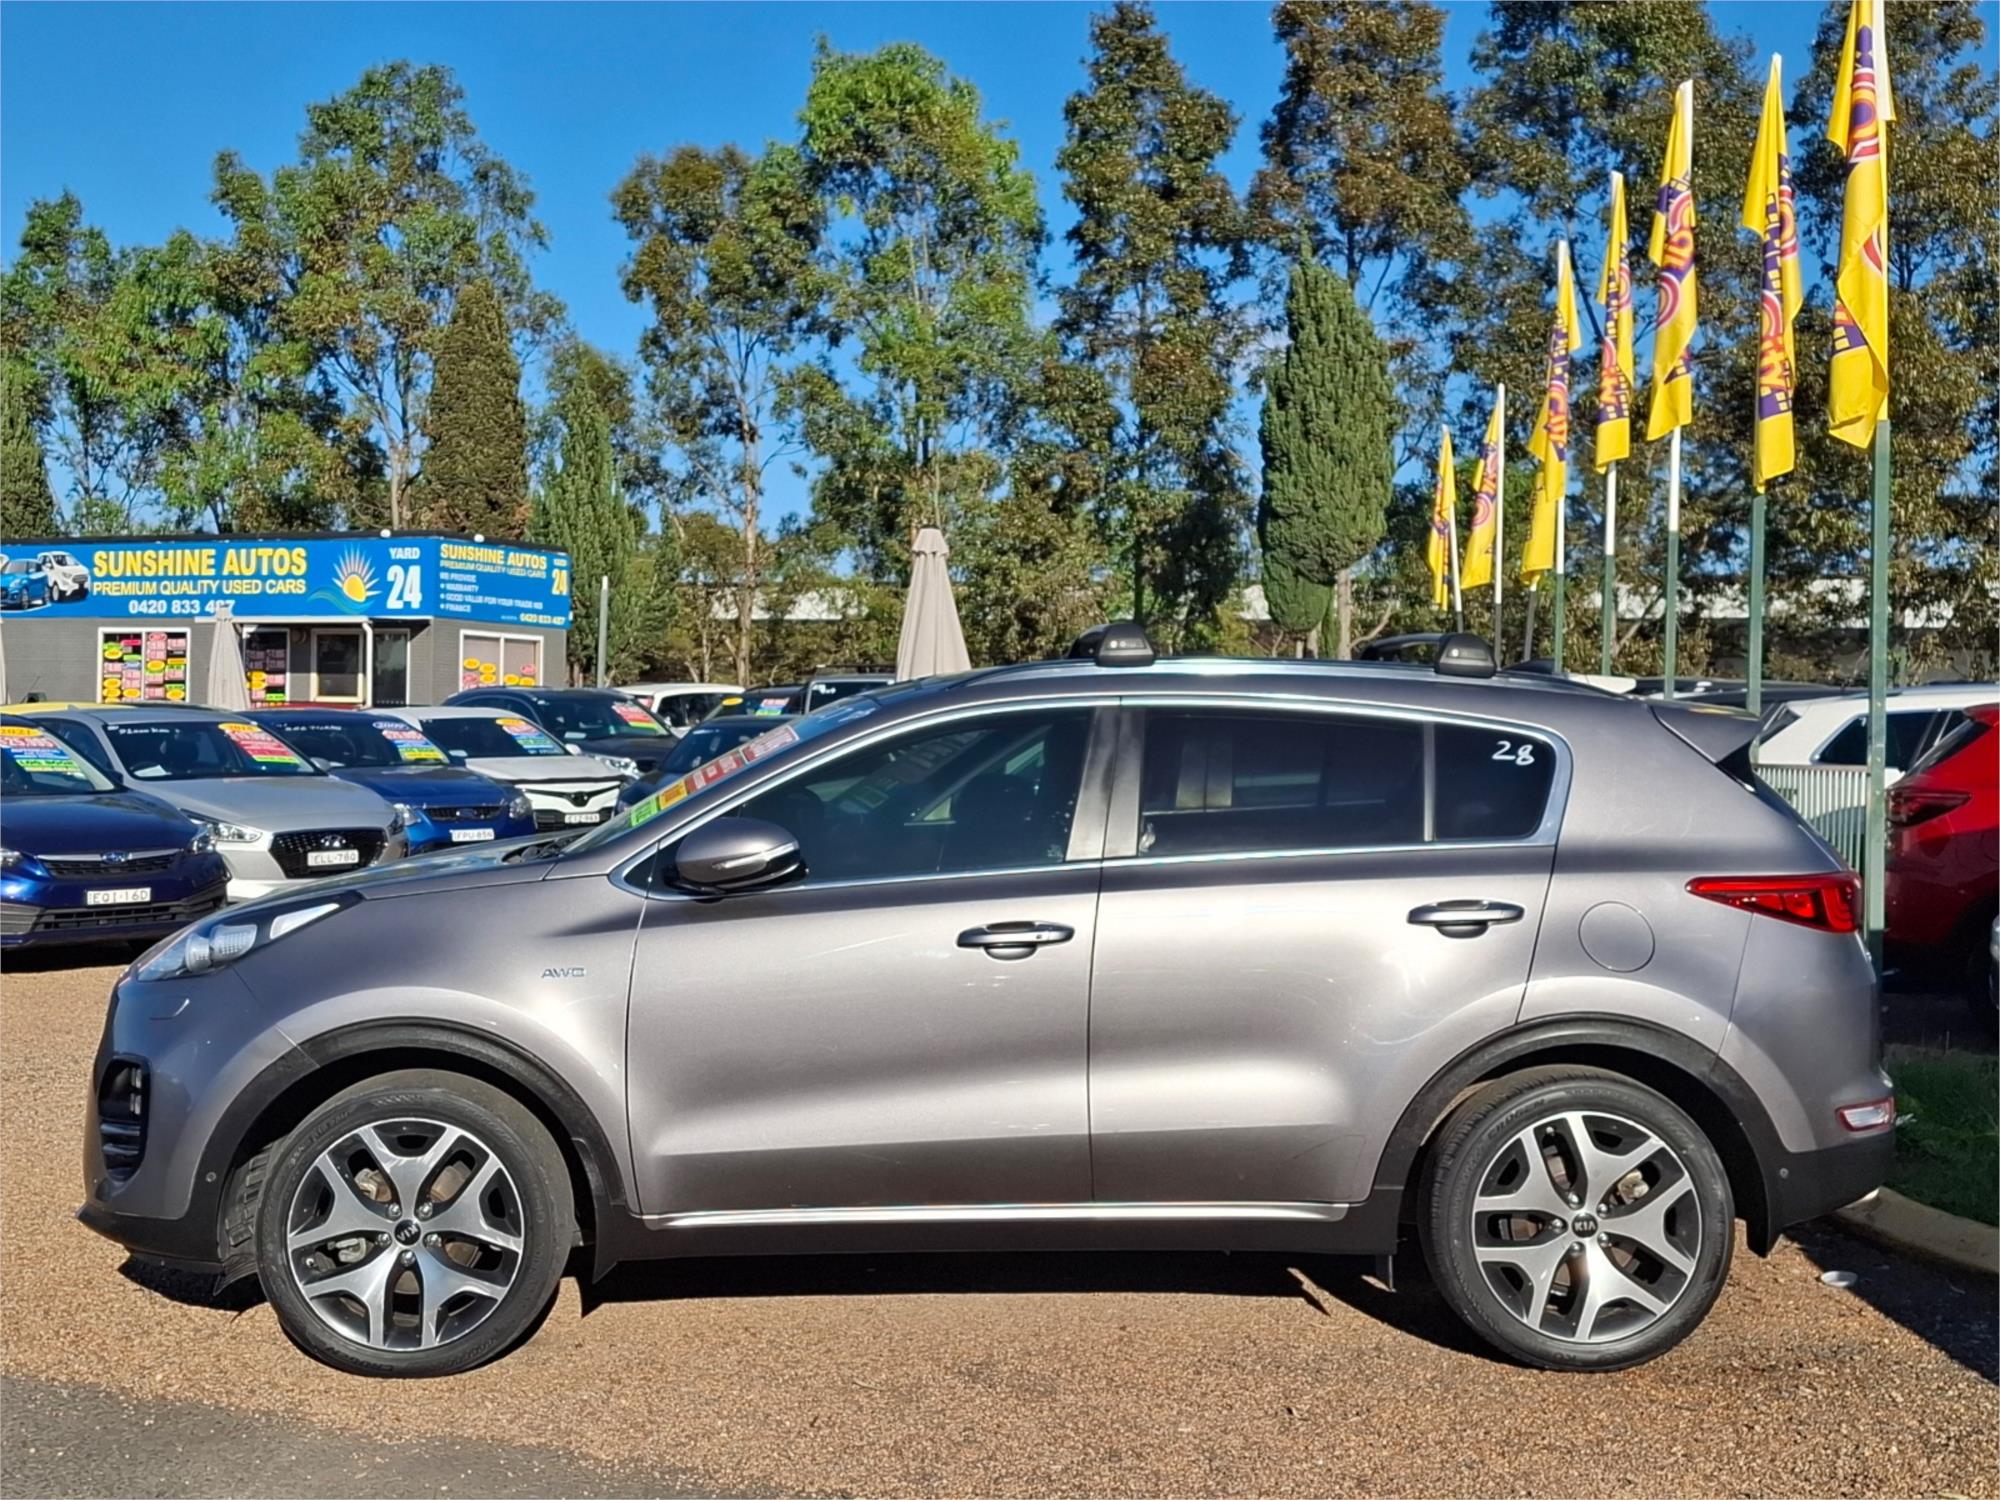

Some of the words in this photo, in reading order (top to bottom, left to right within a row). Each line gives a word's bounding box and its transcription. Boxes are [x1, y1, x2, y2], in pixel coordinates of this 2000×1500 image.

[93, 549, 217, 578] SUNSHINE
[222, 547, 307, 576] AUTOS
[389, 547, 421, 560] YARD
[440, 543, 505, 565] SUNSHINE
[507, 551, 547, 570] AUTOS
[440, 560, 476, 570] PREMIUM
[476, 563, 506, 574] QUALITY
[527, 569, 547, 579] CARS
[93, 581, 157, 596] PREMIUM
[160, 579, 220, 595] QUALITY
[222, 579, 262, 595] USED
[265, 578, 307, 595] CARS
[386, 564, 423, 609] 24
[551, 568, 569, 595] 24
[128, 599, 168, 614] 0420
[171, 599, 201, 614] 833
[1491, 740, 1536, 766] 28
[541, 967, 586, 978] AWD
[396, 1223, 419, 1242] KIA
[1574, 1220, 1596, 1232] KIA
